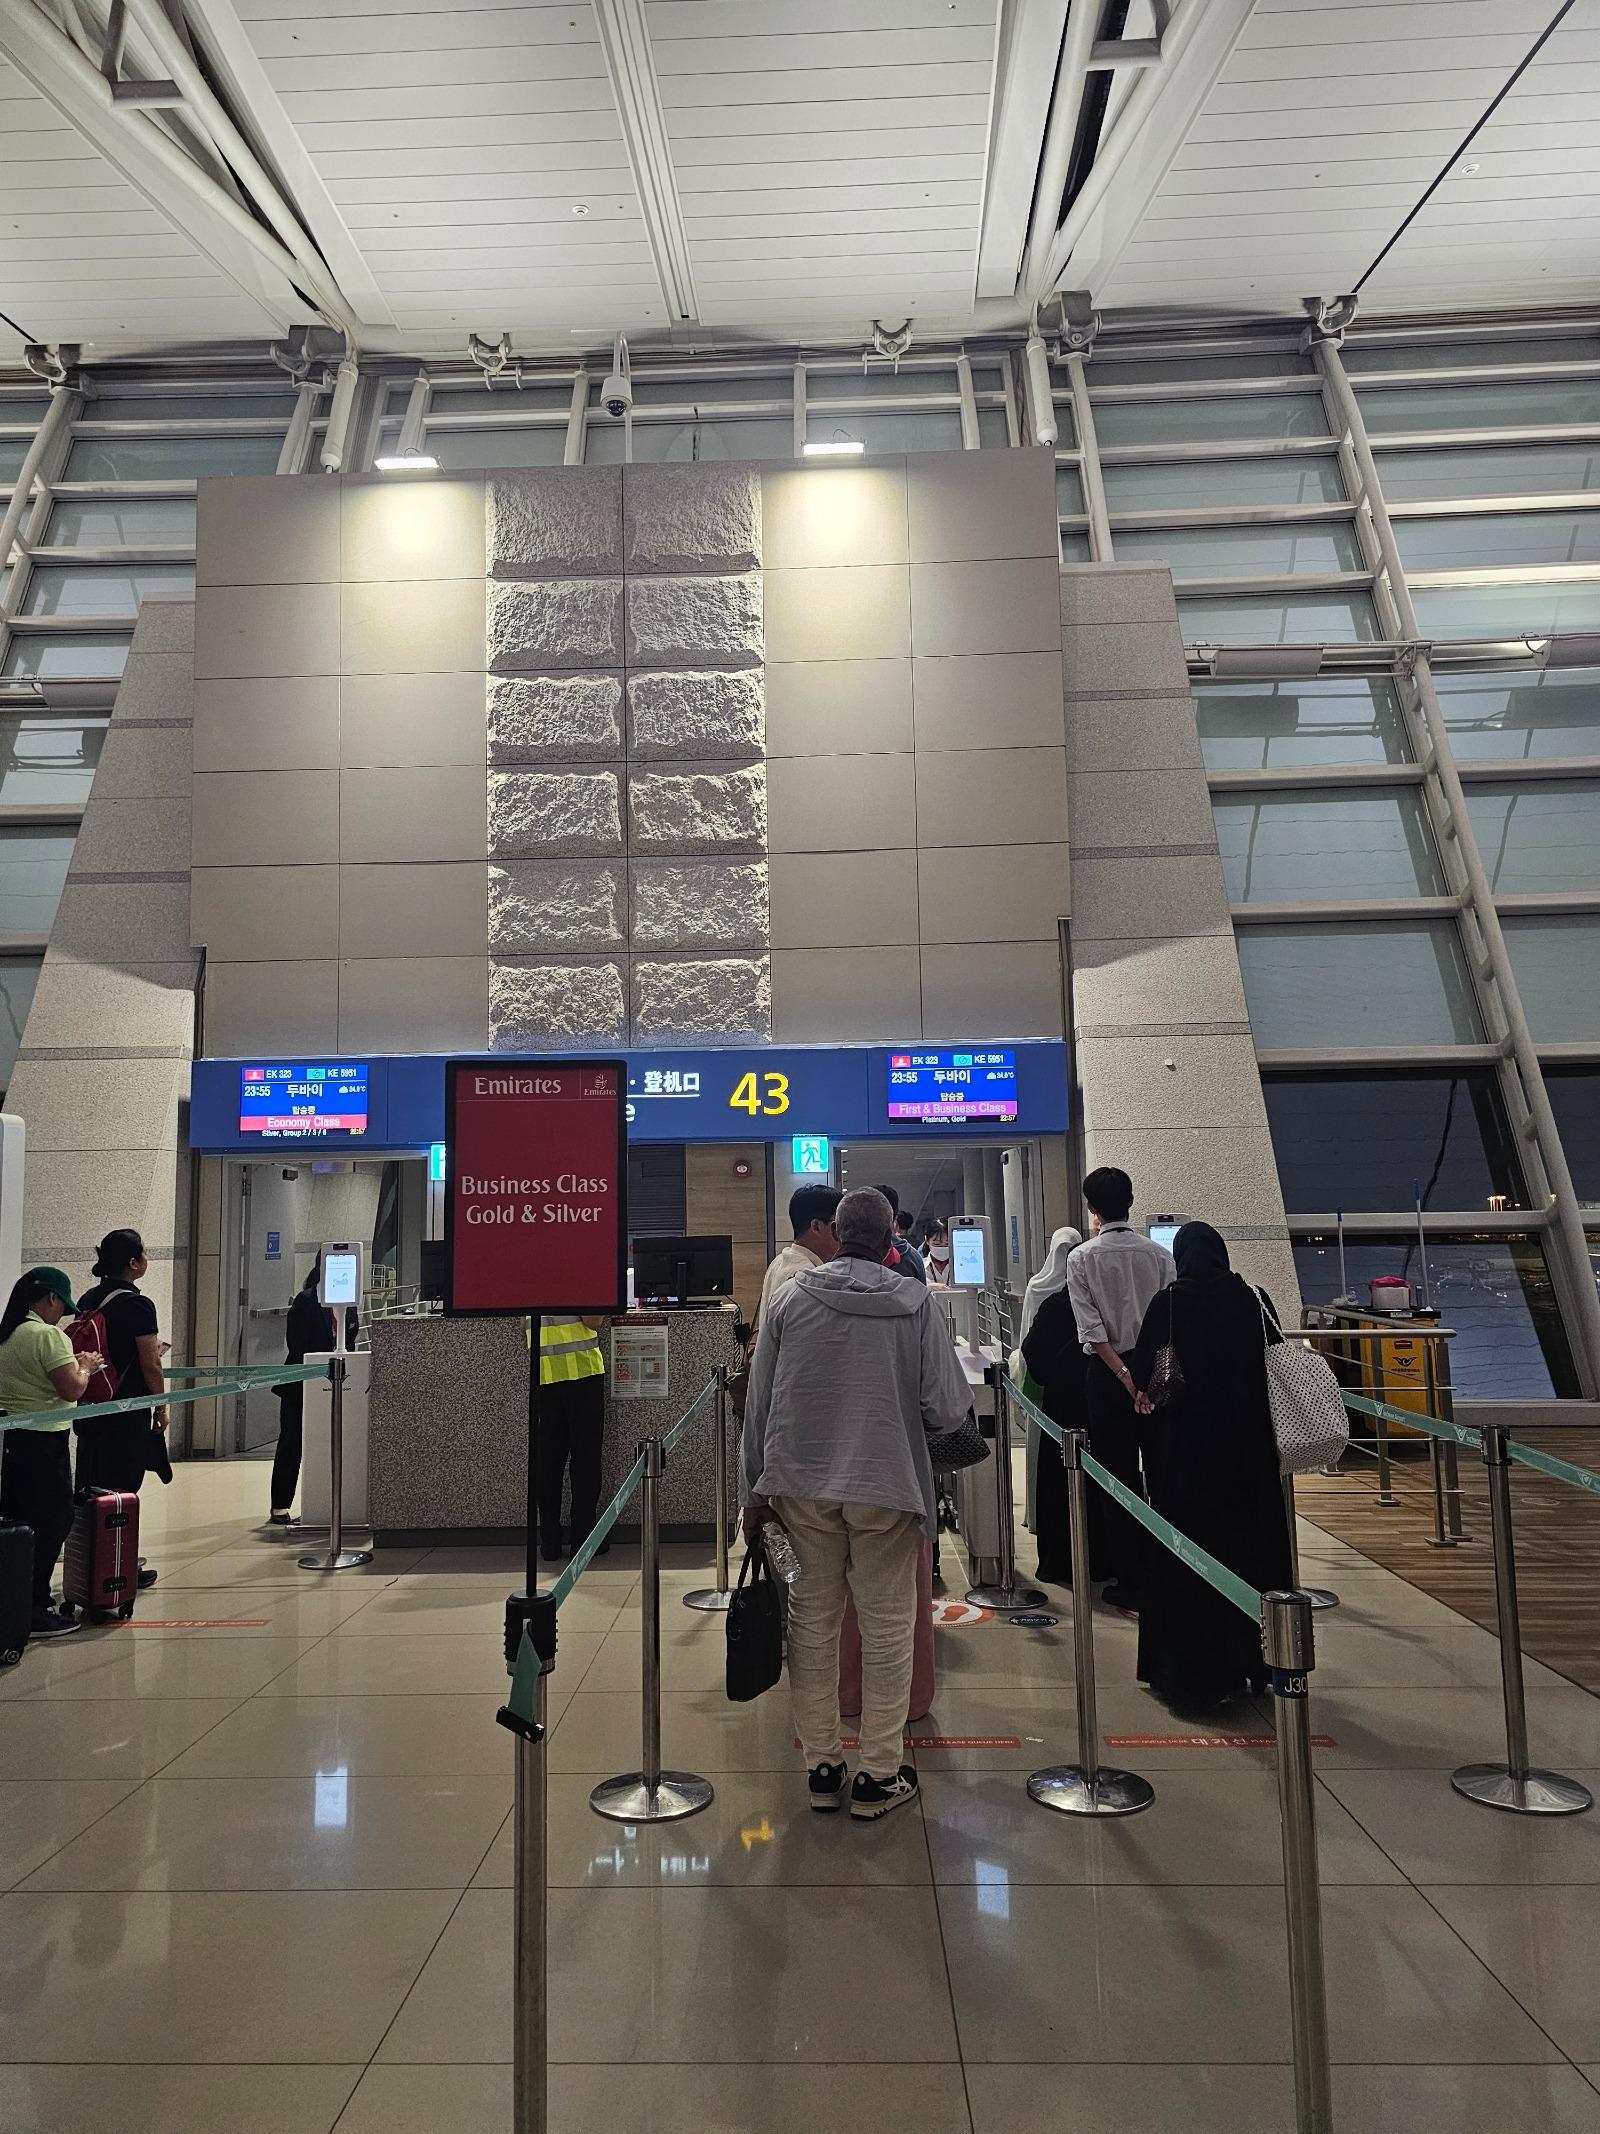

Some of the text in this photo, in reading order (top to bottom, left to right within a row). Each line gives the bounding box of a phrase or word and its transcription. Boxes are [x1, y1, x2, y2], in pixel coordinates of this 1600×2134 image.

[912, 1056, 939, 1065] EK 323
[974, 1055, 986, 1064] KE
[266, 1069, 292, 1079] EK 323
[327, 1068, 357, 1077] KE 5951
[891, 1072, 918, 1084] 23:55
[933, 1069, 971, 1085] 두바이
[474, 1076, 562, 1096] Emirates
[643, 1070, 701, 1094] 登机口
[244, 1085, 271, 1097] 23:55
[286, 1083, 323, 1098] 두바이
[583, 1087, 617, 1097] Emirates
[729, 1072, 790, 1115] 43
[940, 1092, 965, 1102] 탑승중
[899, 1102, 1007, 1115] First & Business Class
[267, 1116, 340, 1129] Economy Class
[951, 1115, 967, 1123] Gold
[261, 1129, 282, 1138] Silver,
[283, 1129, 302, 1138] Group
[461, 1174, 608, 1195] Business Class
[466, 1203, 603, 1224] Gold & Silver
